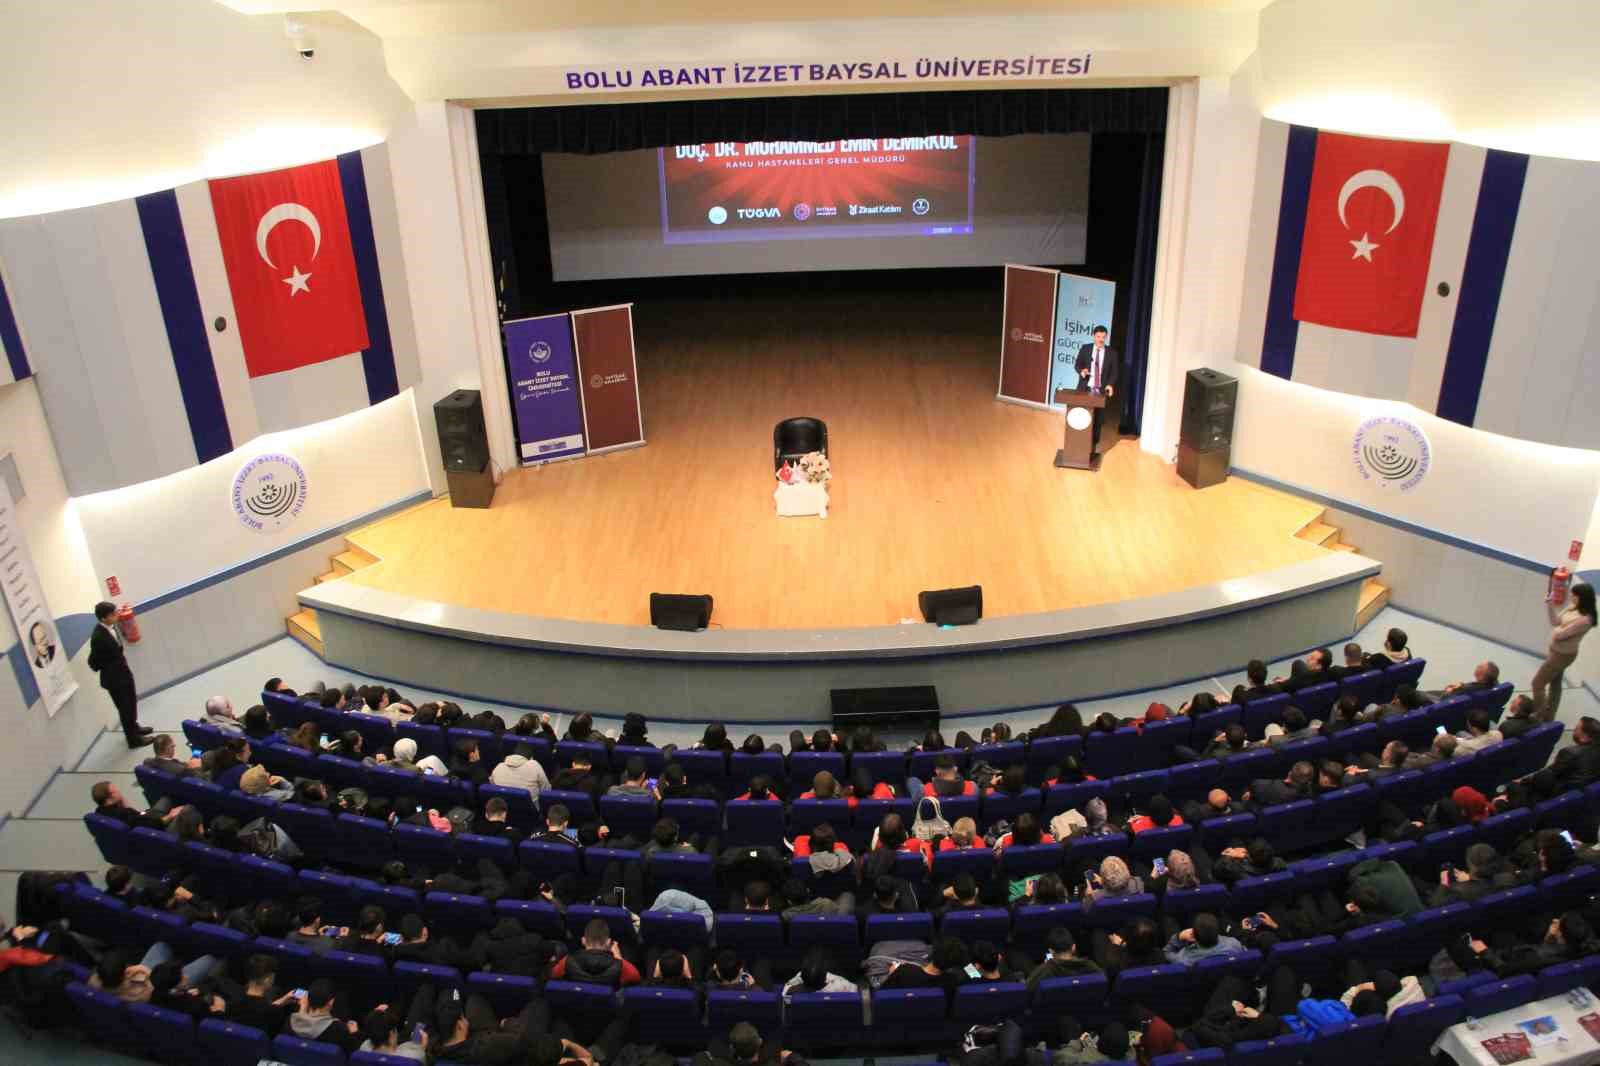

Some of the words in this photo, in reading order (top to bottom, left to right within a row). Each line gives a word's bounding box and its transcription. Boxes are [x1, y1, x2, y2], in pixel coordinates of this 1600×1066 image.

[566, 69, 633, 89] BOLU
[641, 66, 726, 87] ABANT
[734, 63, 804, 84] İZZET
[808, 61, 908, 81] BAYSAL
[915, 54, 1092, 78] ÜNİVERSİTESİ
[726, 160, 754, 169] KAMU
[827, 156, 860, 165] GENEL
[1064, 318, 1095, 337] İŞİMİ
